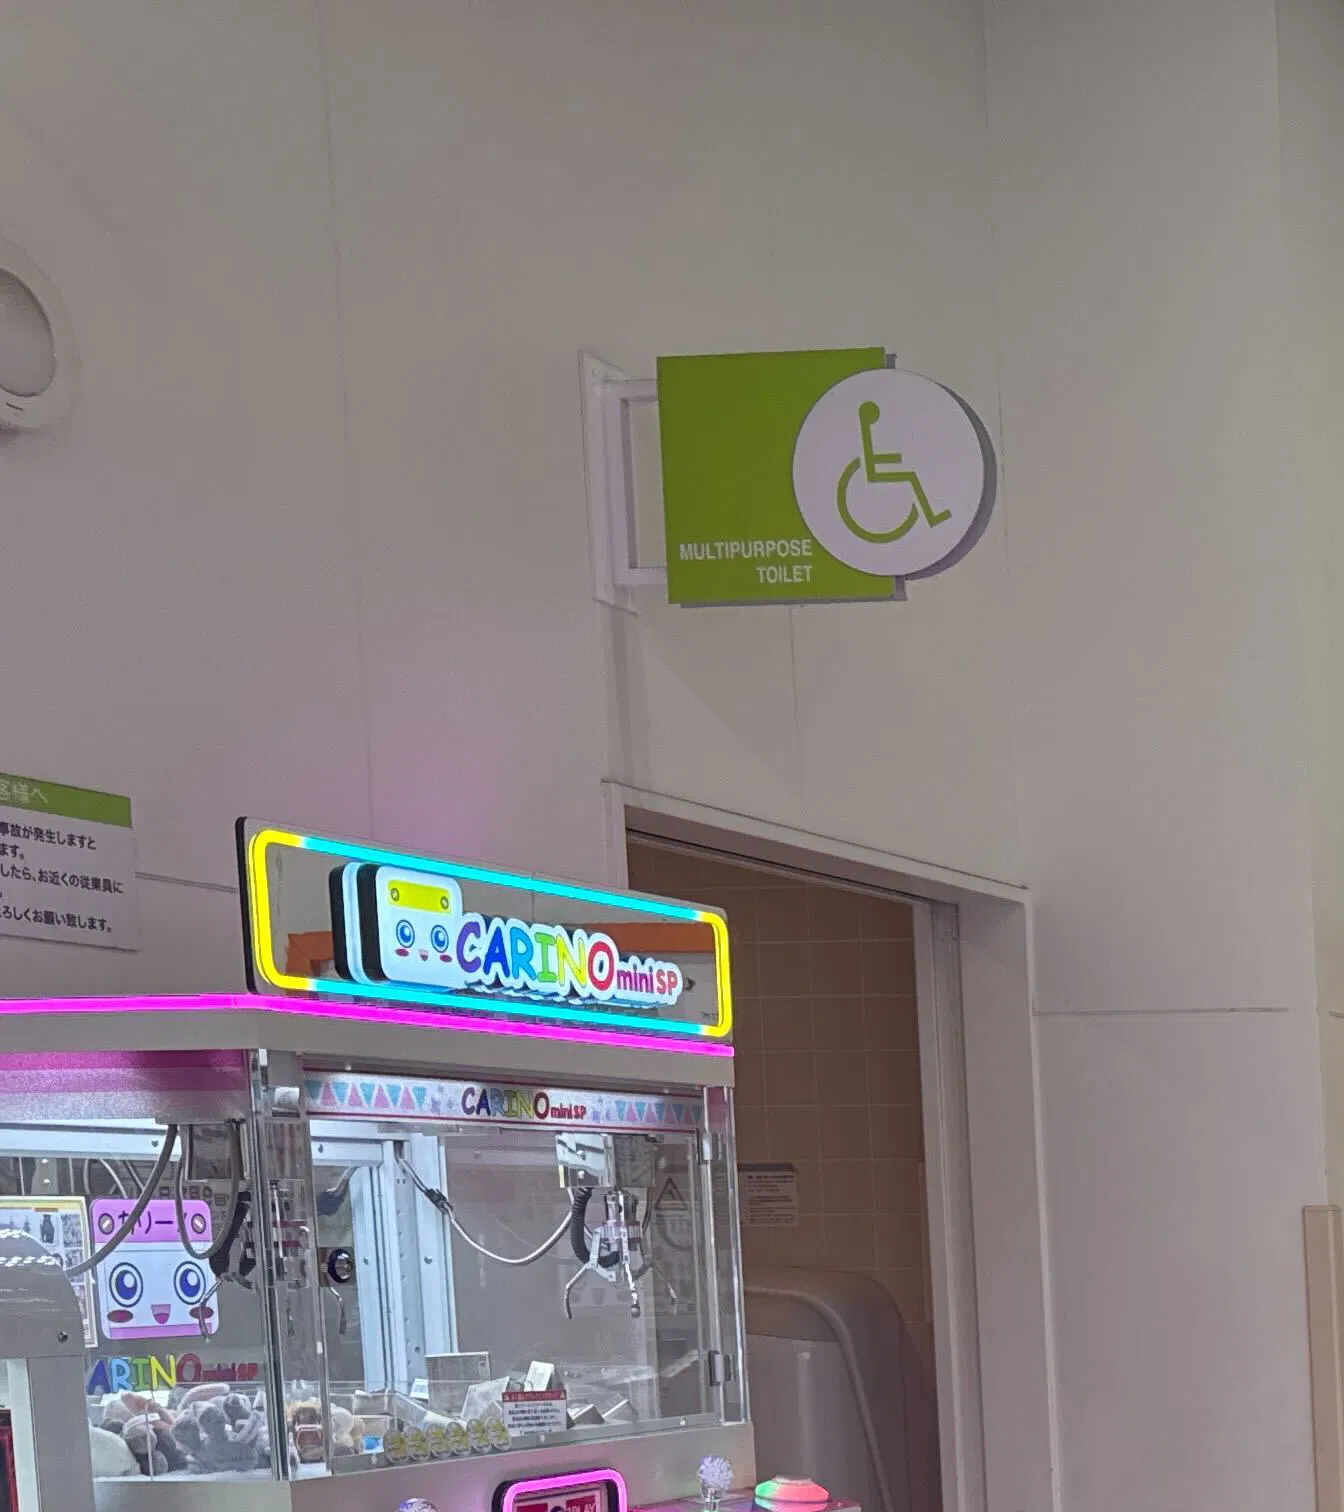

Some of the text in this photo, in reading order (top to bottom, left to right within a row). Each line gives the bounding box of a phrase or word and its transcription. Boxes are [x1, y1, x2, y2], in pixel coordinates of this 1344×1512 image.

[679, 539, 813, 560] MULTIPURPOSE
[756, 564, 813, 584] TOILET
[0, 905, 112, 933] ろしくお願い致します。
[456, 921, 614, 991] CARINO
[461, 1087, 550, 1121] CARINO
